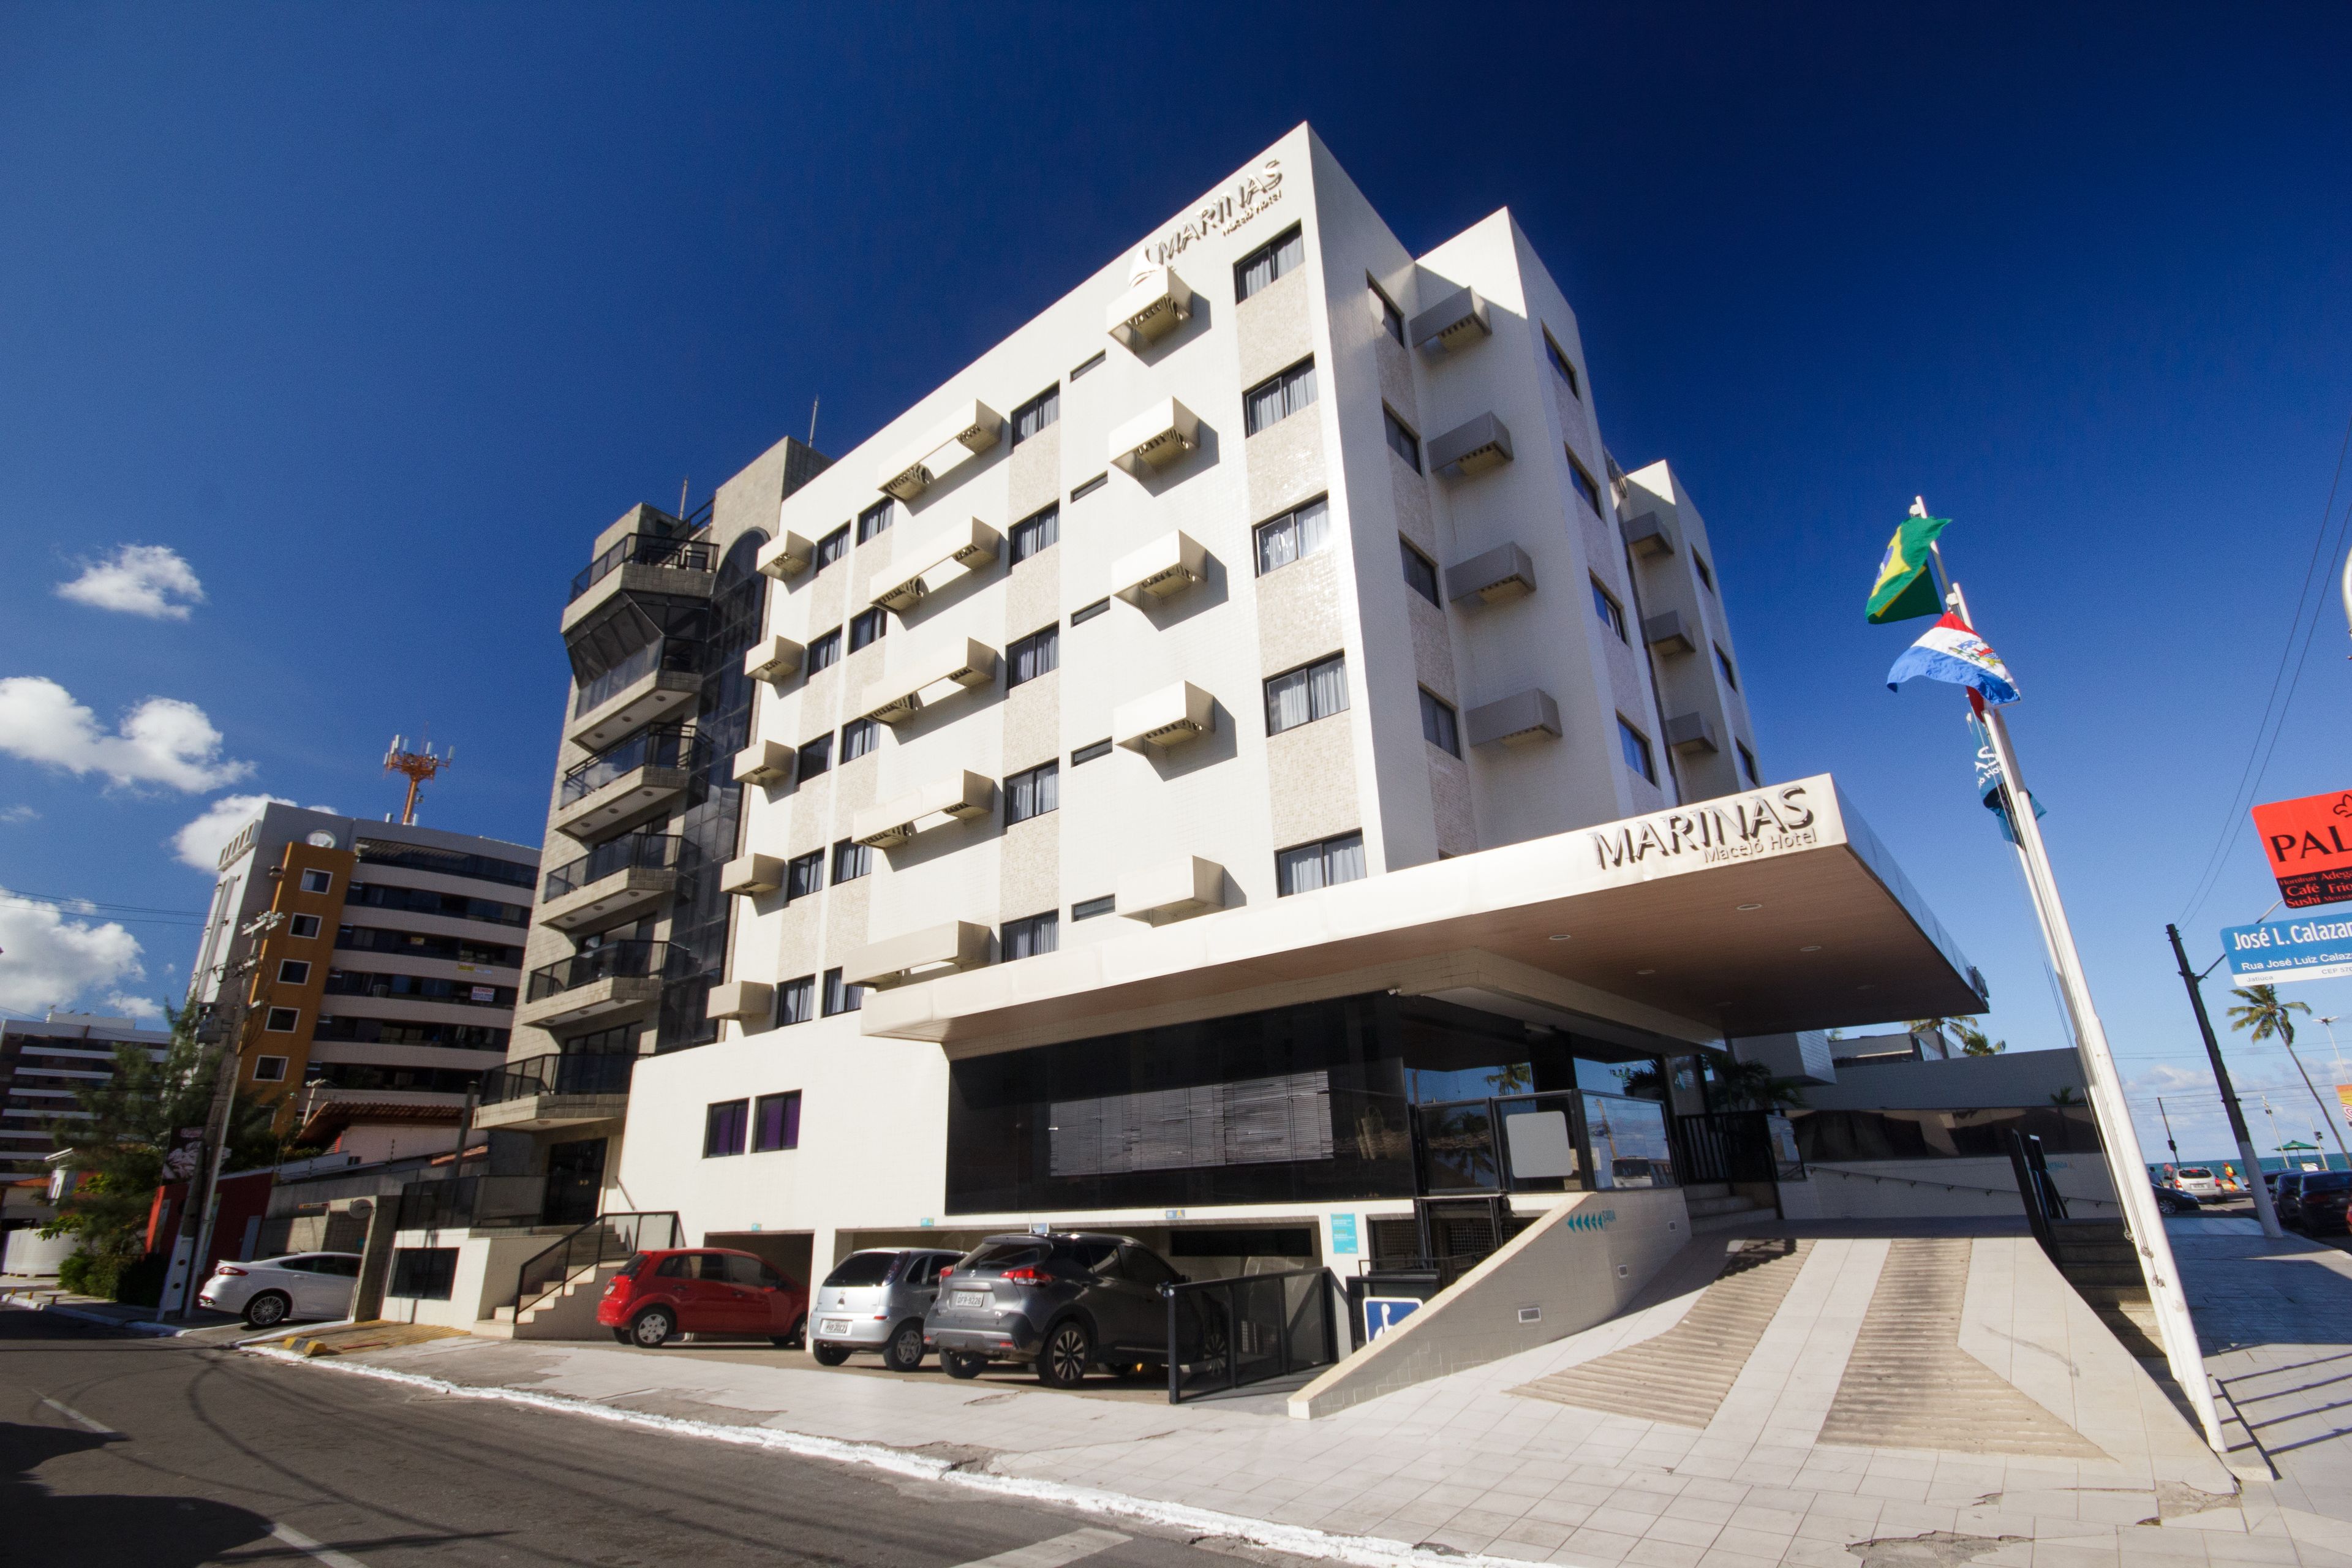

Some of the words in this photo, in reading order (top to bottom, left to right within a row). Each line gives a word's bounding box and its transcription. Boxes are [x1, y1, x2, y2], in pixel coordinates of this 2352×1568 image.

[1155, 158, 1283, 265] MARINAS
[1588, 785, 1814, 870] MARINAS
[1702, 837, 1764, 864] Maceió
[1768, 827, 1817, 851] Hotel
[2269, 825, 2352, 862] PAL
[2286, 883, 2320, 896] Café
[2286, 895, 2321, 907] Sushi
[2234, 927, 2271, 951] José
[2272, 927, 2291, 946] L.
[2241, 962, 2264, 971] Rua
[2266, 958, 2293, 968] José
[2294, 955, 2318, 966] Luiz
[2320, 952, 2352, 963] Calaz
